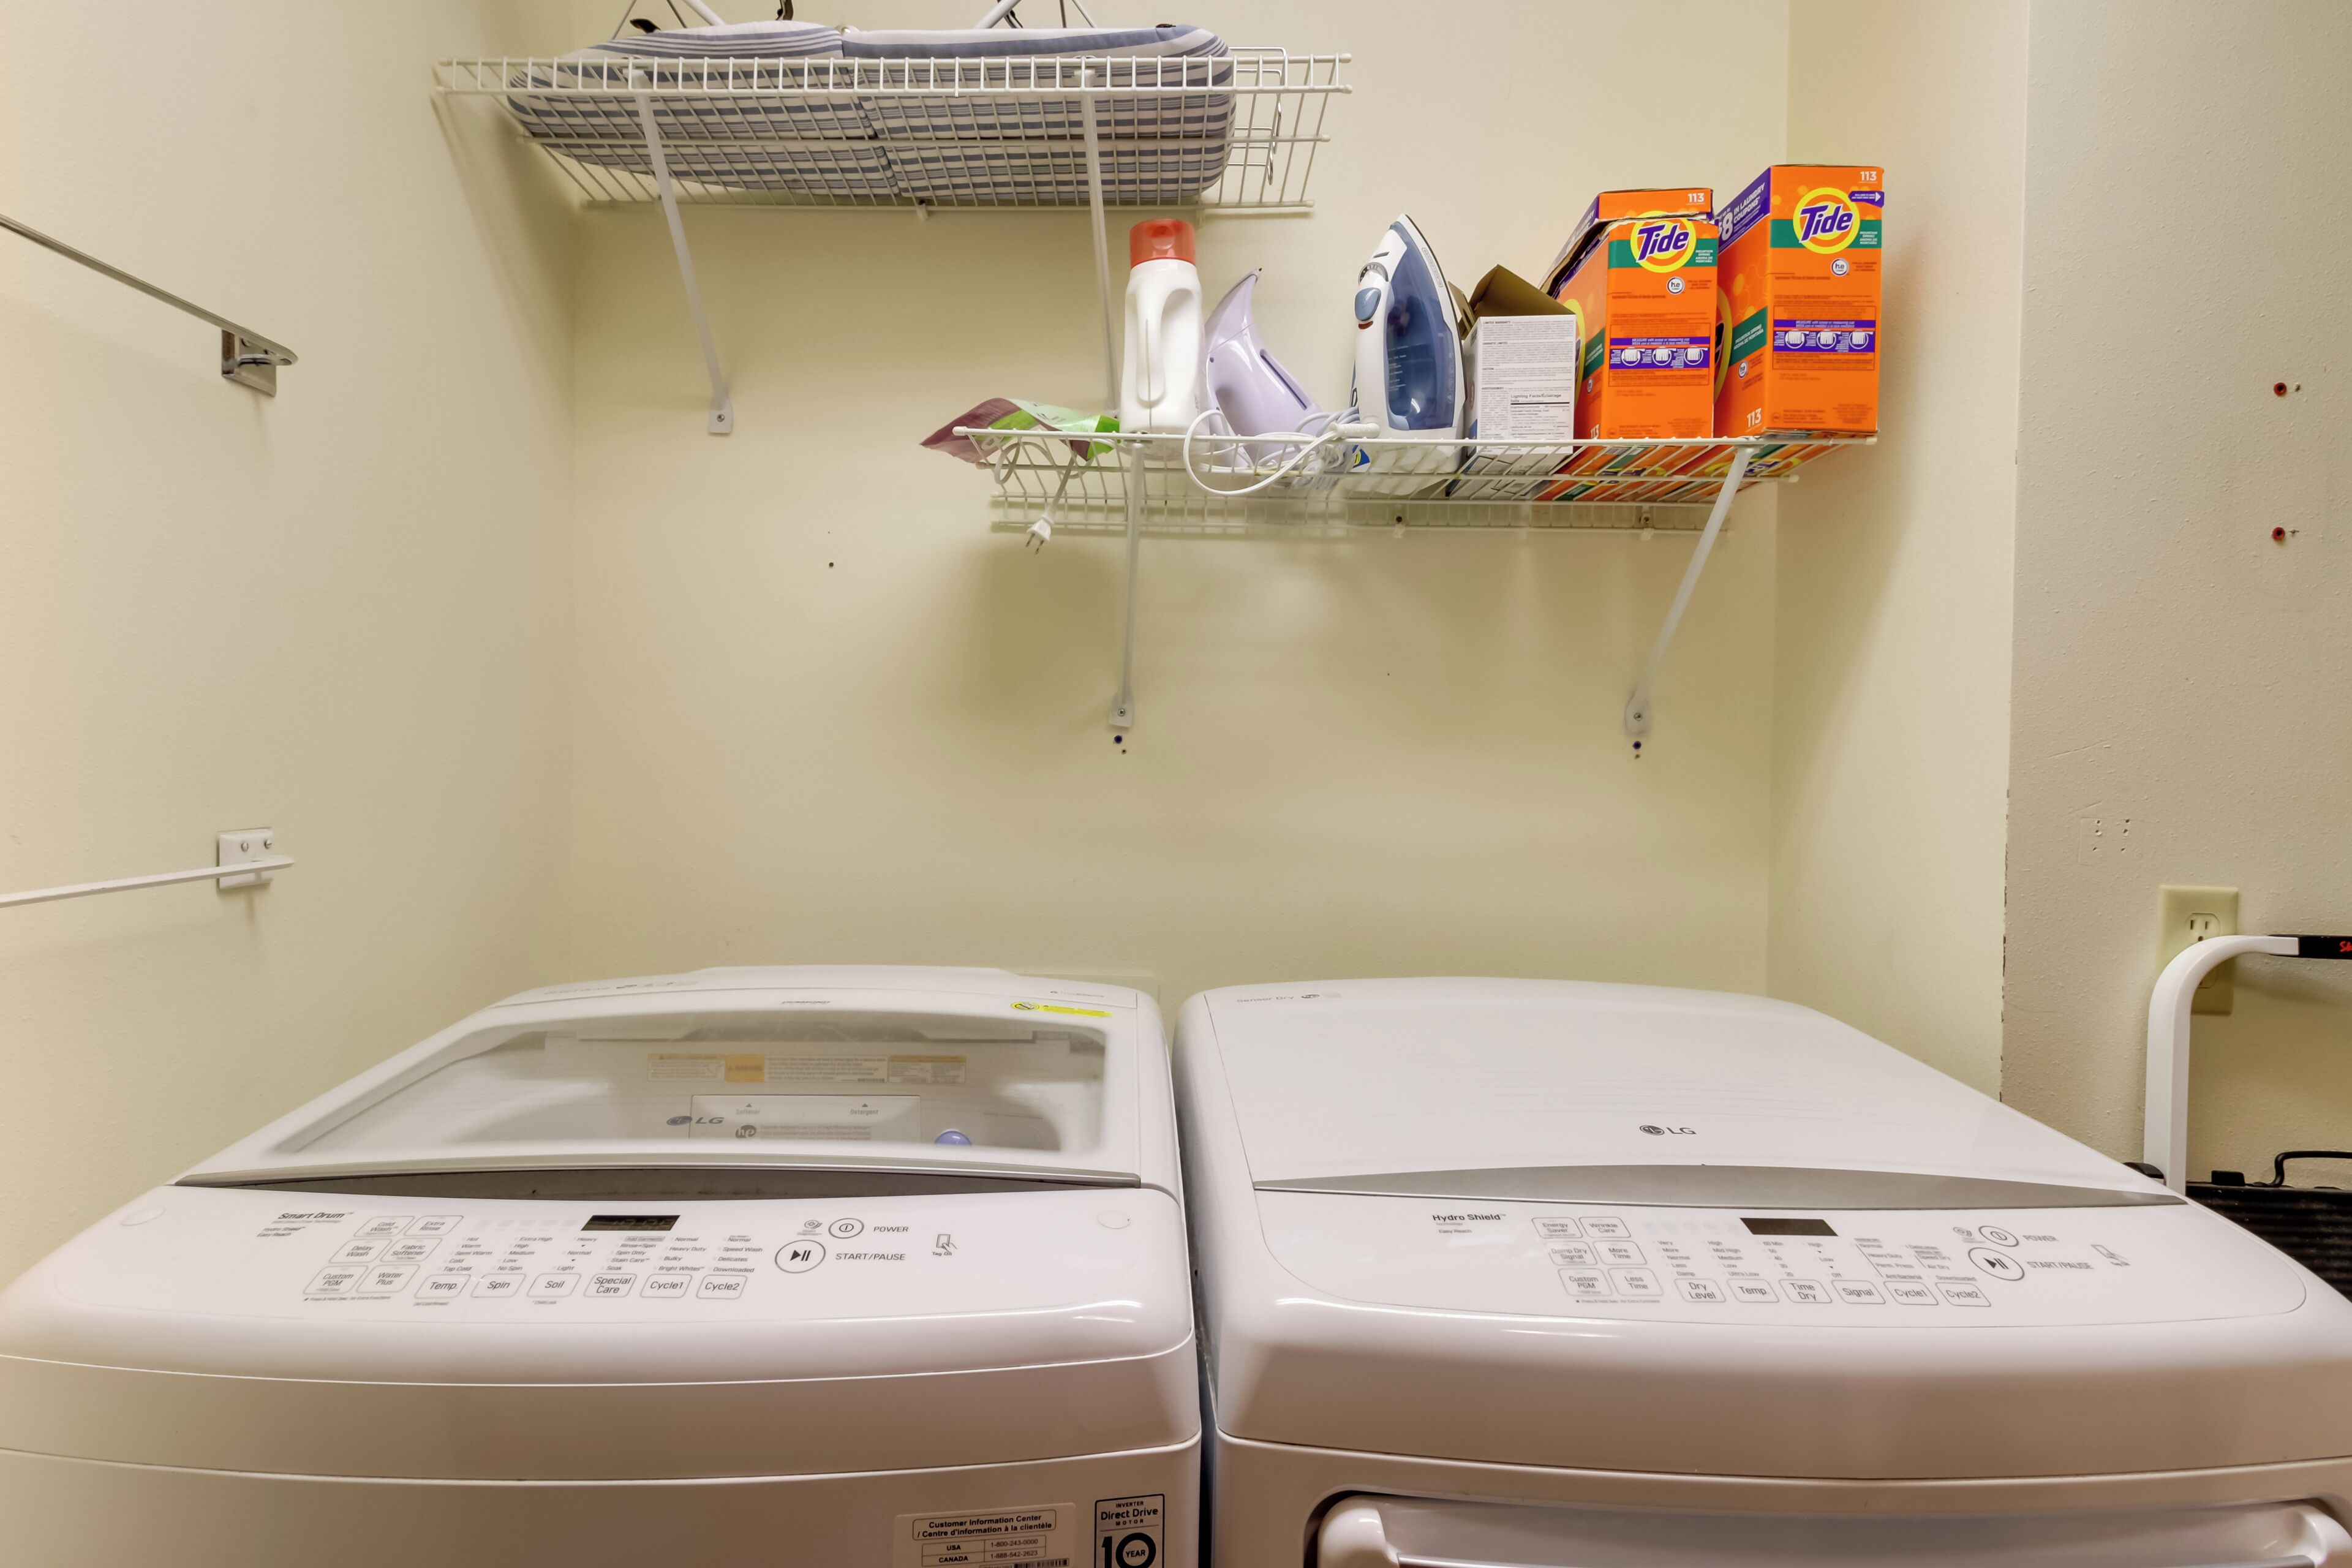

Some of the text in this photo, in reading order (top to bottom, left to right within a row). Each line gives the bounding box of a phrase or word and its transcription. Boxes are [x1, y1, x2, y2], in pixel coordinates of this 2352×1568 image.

[1860, 172, 1877, 181] 113
[1687, 193, 1705, 203] 113
[1733, 206, 1740, 216] IN
[1740, 183, 1765, 210] LAUNDRY
[1799, 203, 1853, 243] Tide
[1636, 223, 1689, 263] Tide
[1747, 407, 1762, 428] 113
[1590, 424, 1599, 439] 113
[835, 1253, 907, 1261] START/PAUSE
[2026, 1261, 2094, 1270] START/PAUSE
[487, 1281, 510, 1290] Spin
[594, 1276, 632, 1285] Special
[596, 1285, 620, 1294] Care
[650, 1281, 684, 1291] Cycle1
[705, 1282, 740, 1292] Cycle2
[1688, 1282, 1706, 1292] Dry
[1798, 1292, 1817, 1302] Dry
[1842, 1287, 1875, 1297] Signal
[1894, 1289, 1928, 1298] Cycle1
[1945, 1289, 1981, 1299] Cycle2
[1101, 1508, 1158, 1520] Direct Drive
[929, 1520, 967, 1529] Customer
[969, 1517, 1014, 1526] Information
[951, 1526, 1003, 1536] d'information
[1020, 1522, 1052, 1531] clientèle
[990, 1539, 1038, 1548] 1-800-243-0000
[990, 1550, 1038, 1559] 1-888-542-2623
[1101, 1532, 1156, 1568] 10
